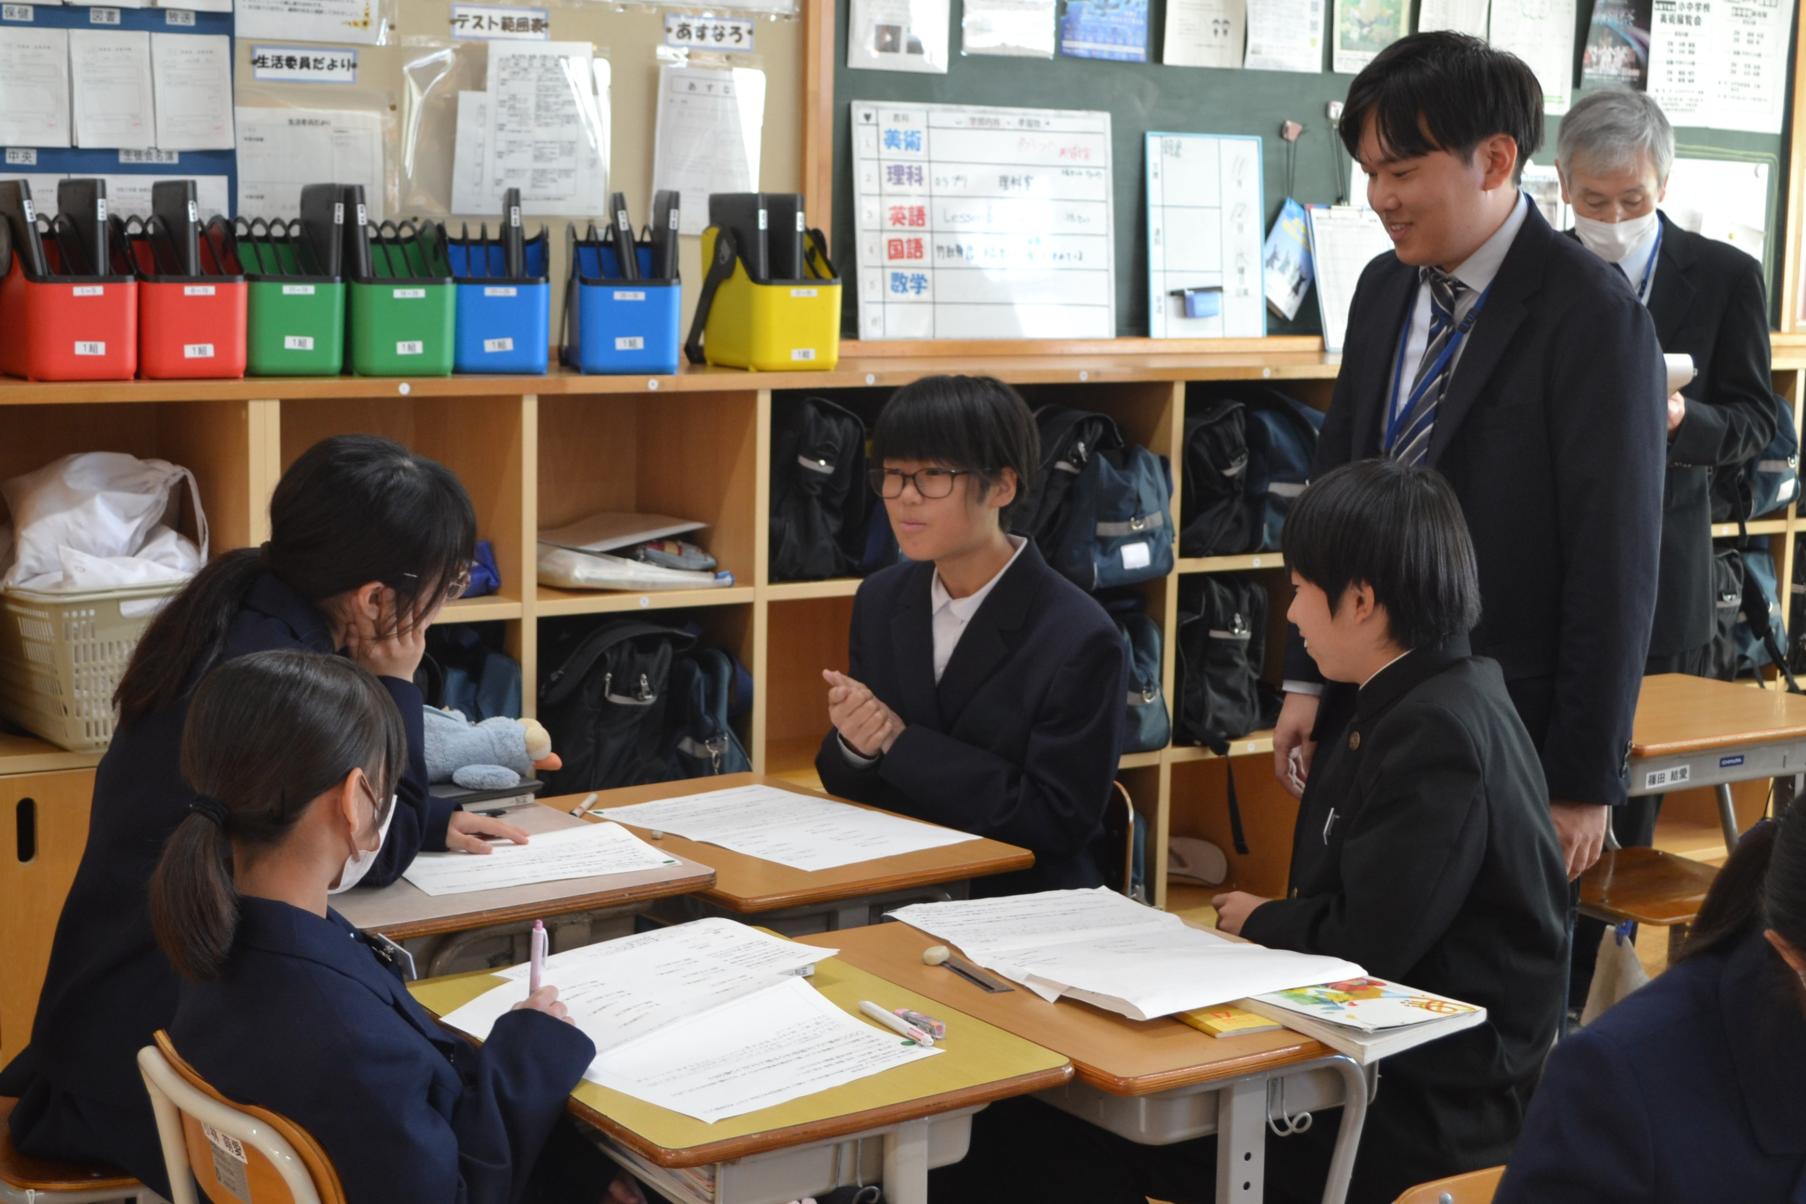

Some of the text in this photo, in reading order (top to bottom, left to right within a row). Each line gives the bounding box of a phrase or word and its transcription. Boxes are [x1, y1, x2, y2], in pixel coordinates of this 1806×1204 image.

[4, 6, 30, 19] 保健
[92, 8, 116, 23] 図書
[168, 11, 193, 24] 放送
[456, 14, 545, 32] テスト範囲表
[676, 22, 743, 43] あすなろ
[257, 54, 351, 71] 生活委員だより
[884, 128, 922, 151] 美術
[8, 150, 34, 163] 中央
[886, 164, 923, 186] 理科
[889, 205, 926, 227] 英語
[887, 237, 924, 260] 国語
[890, 272, 928, 295] 数学
